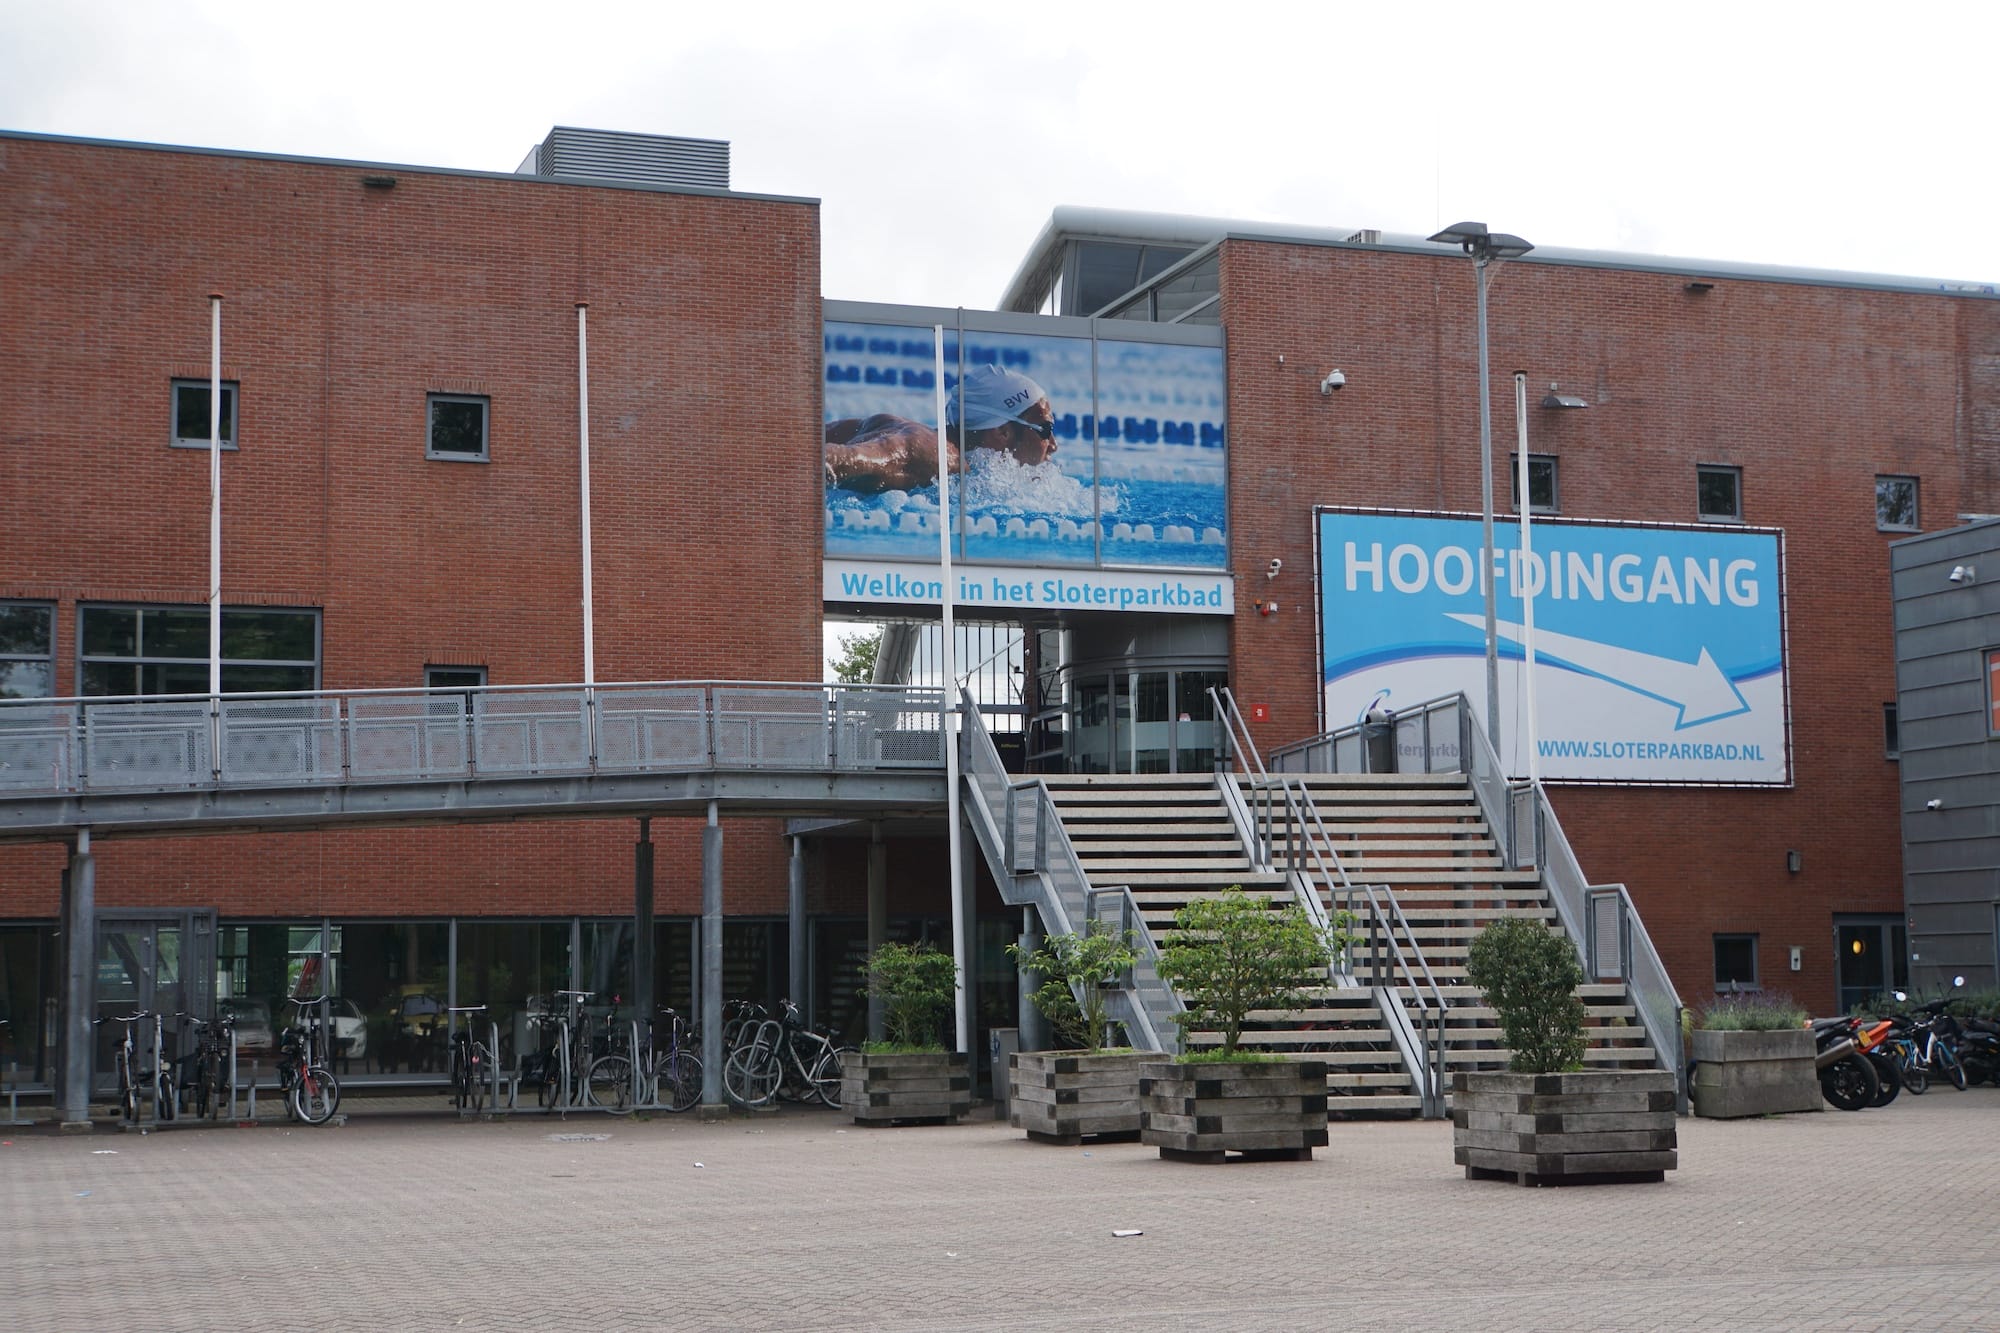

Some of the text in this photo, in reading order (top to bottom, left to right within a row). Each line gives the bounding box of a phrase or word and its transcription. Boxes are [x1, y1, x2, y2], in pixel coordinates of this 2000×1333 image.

[1344, 541, 1760, 607] HOOFDINGANG
[961, 576, 983, 601] in
[993, 577, 1034, 602] het
[1042, 580, 1222, 610] Sloterparkbad
[1537, 739, 1765, 761] WWW.SLOTERPARKBAD.NL
